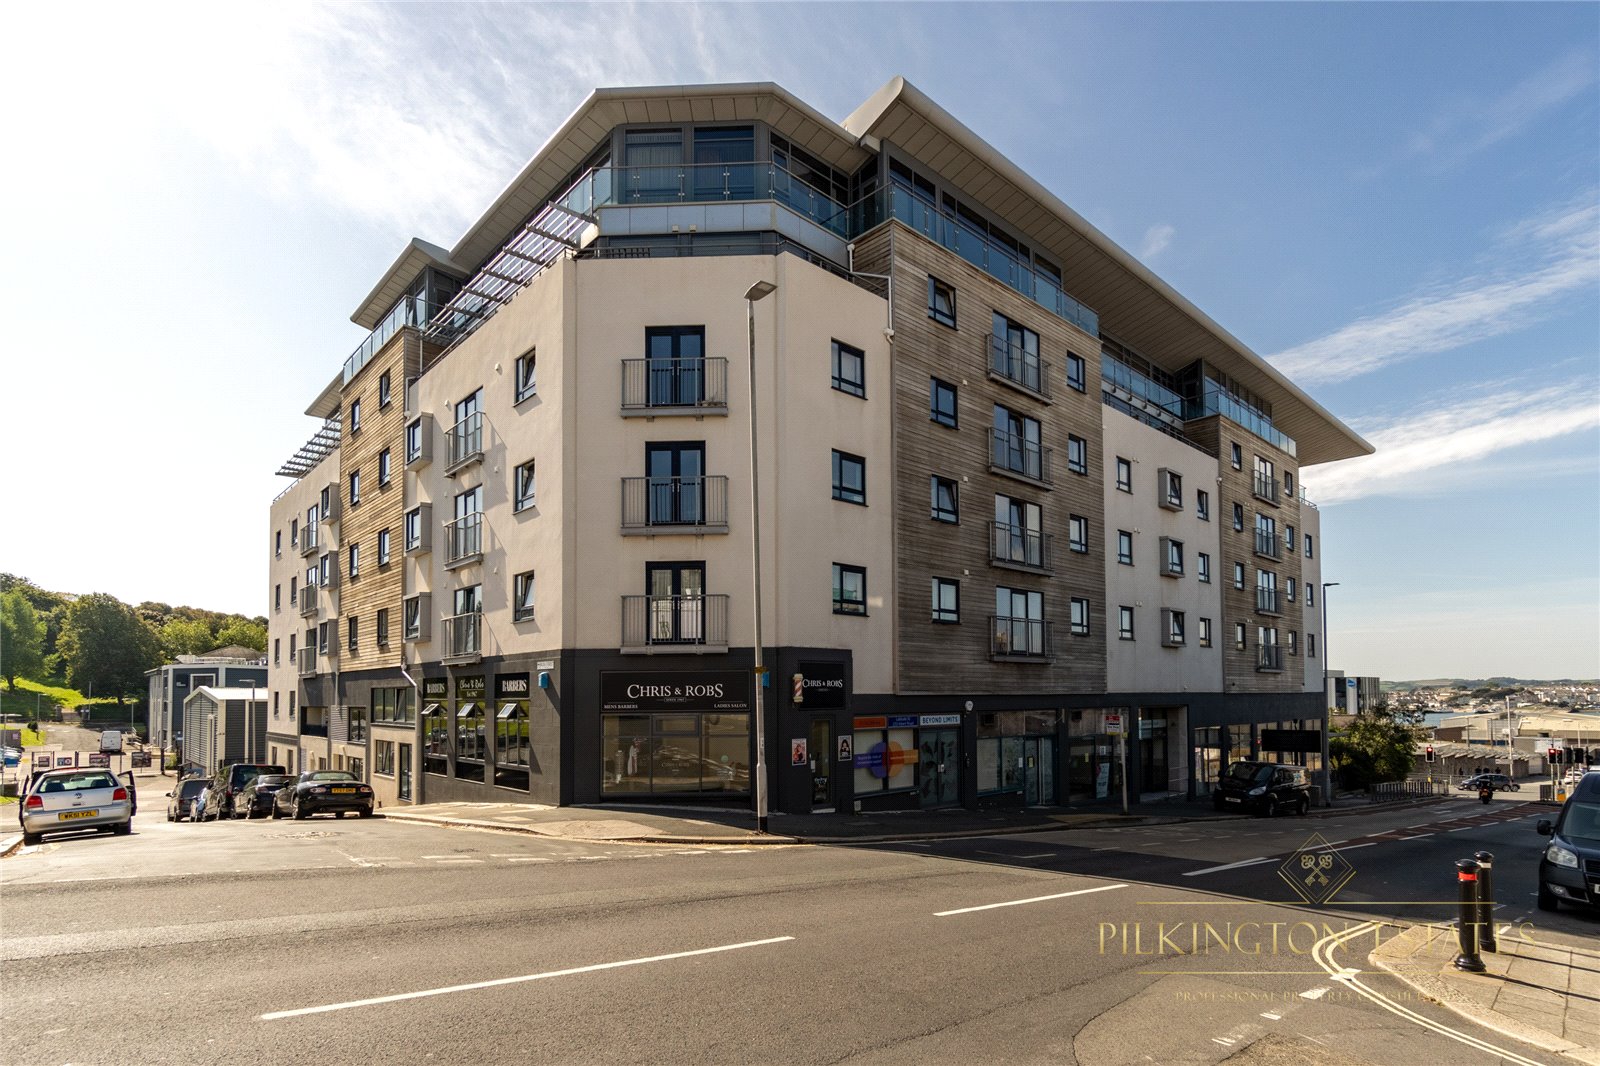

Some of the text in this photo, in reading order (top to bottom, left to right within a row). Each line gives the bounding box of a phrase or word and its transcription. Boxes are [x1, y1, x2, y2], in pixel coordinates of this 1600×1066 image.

[426, 682, 445, 694] BARBERS
[502, 679, 527, 692] BARBERS
[802, 678, 821, 688] CHRIS
[826, 679, 843, 688] ROBS
[626, 683, 724, 699] CHRIS & ROBS
[922, 716, 942, 724] BEYOND
